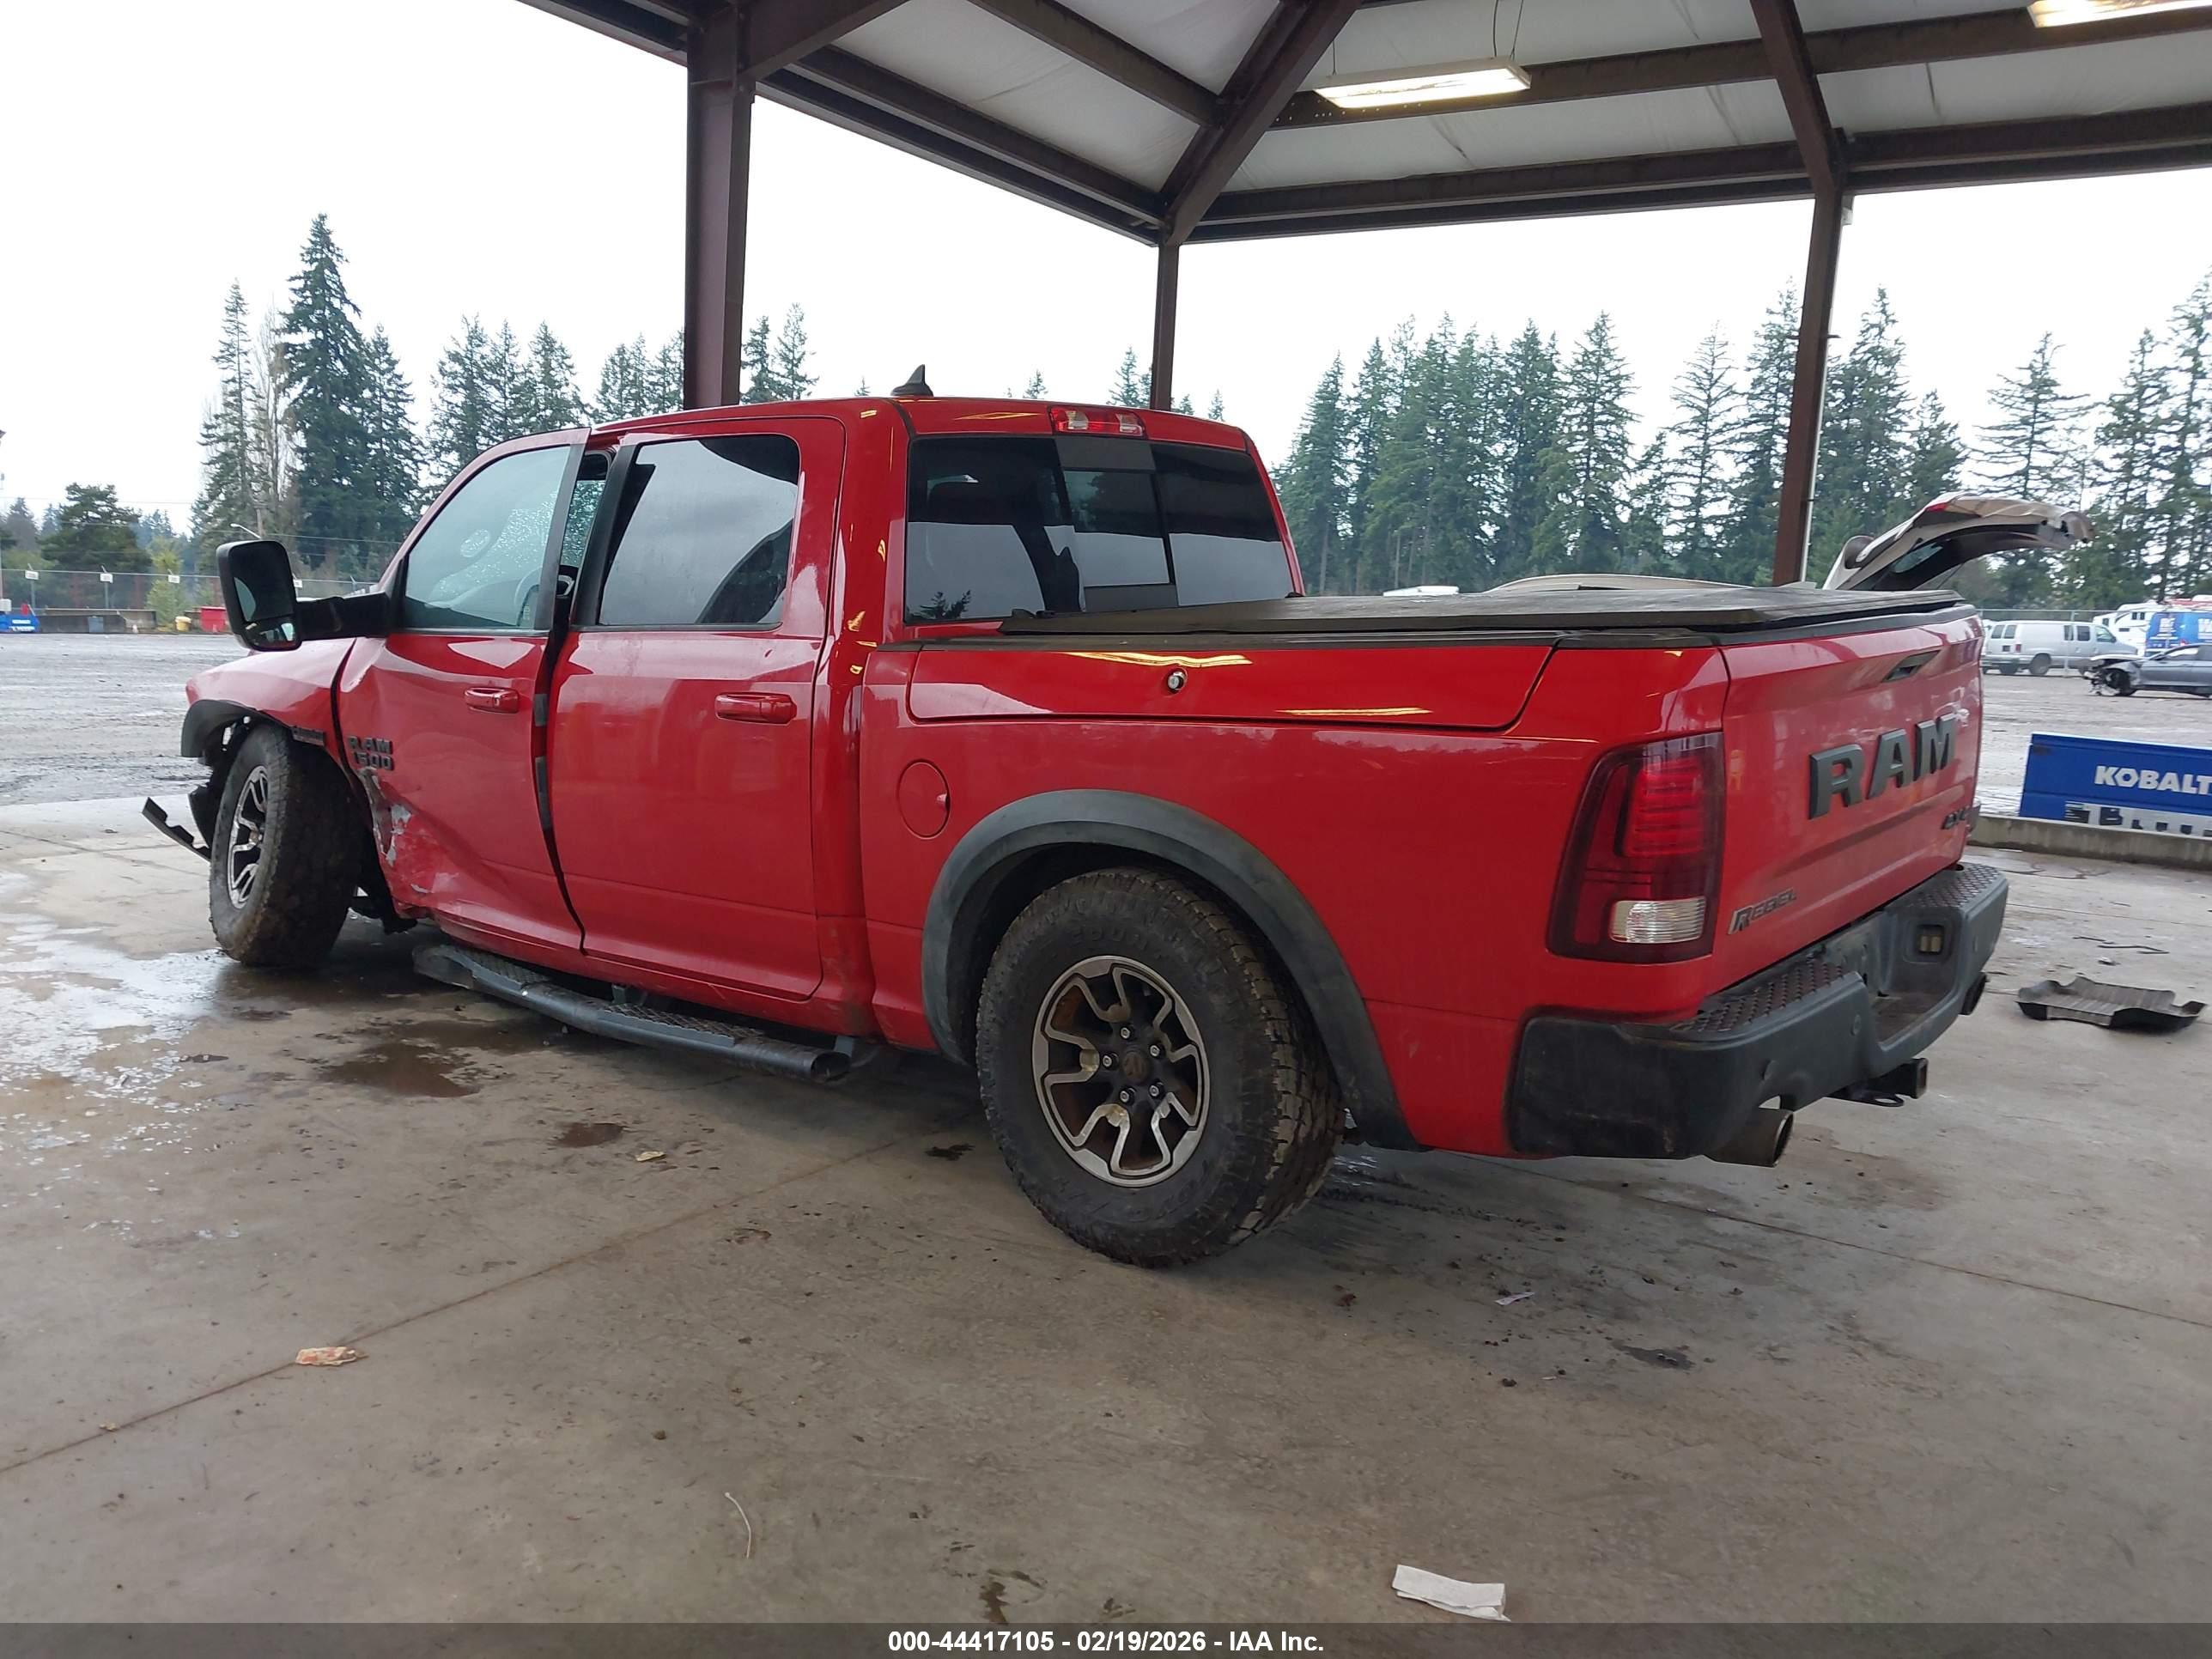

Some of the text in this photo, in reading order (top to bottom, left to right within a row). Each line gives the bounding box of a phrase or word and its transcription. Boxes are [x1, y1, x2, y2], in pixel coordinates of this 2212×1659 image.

[347, 735, 394, 755] RAM
[1808, 714, 1957, 820] RAM
[2094, 765, 2212, 796] KOBALT
